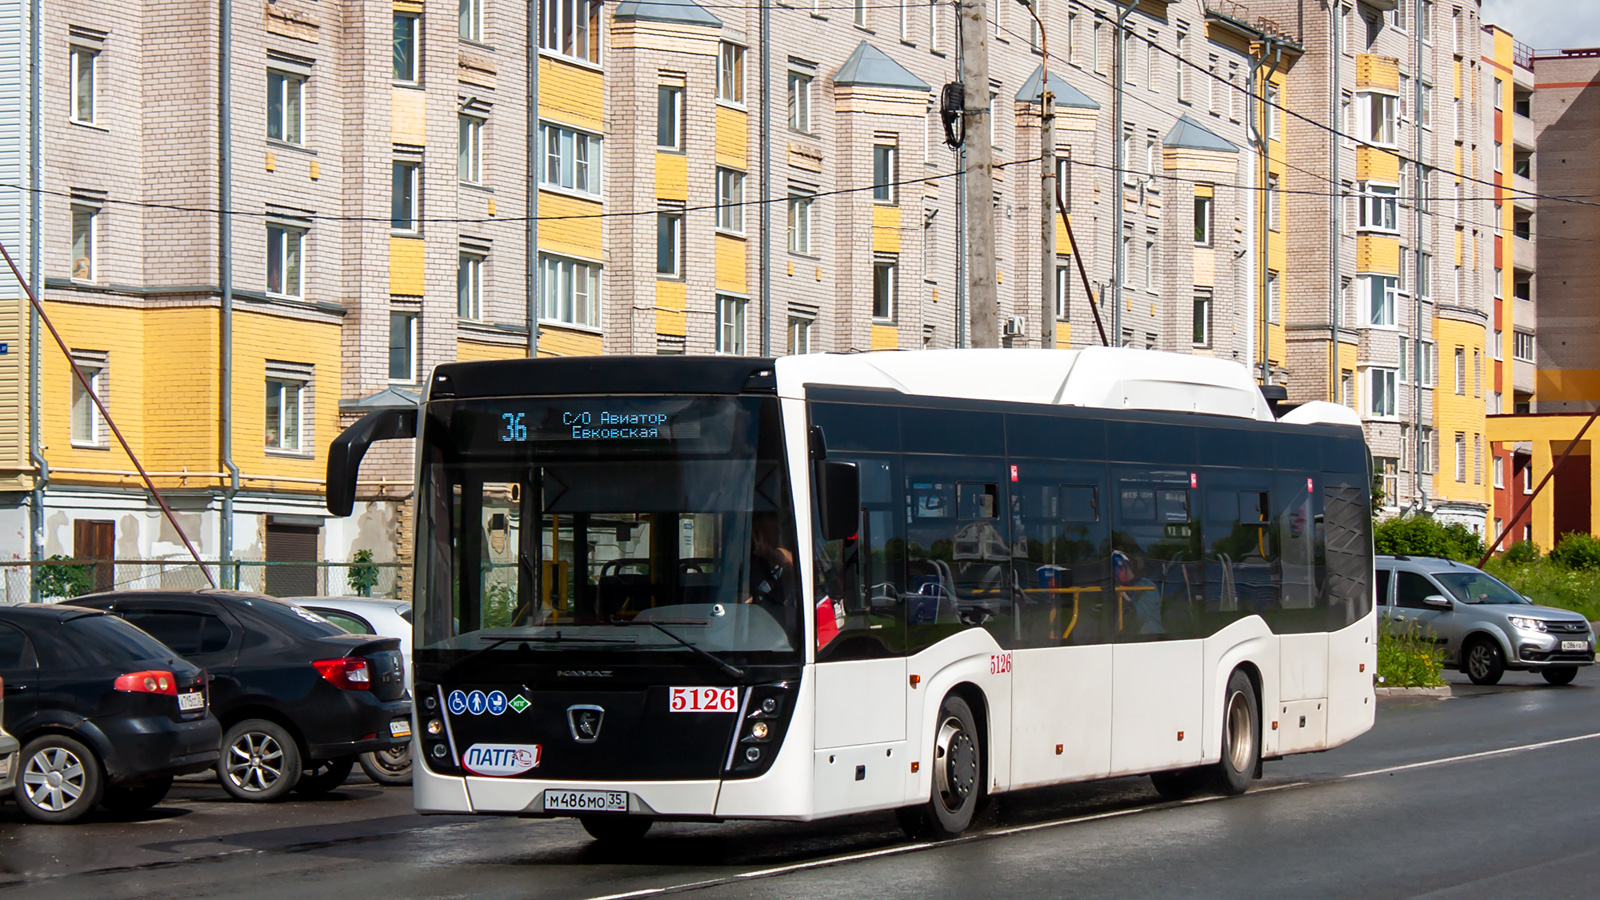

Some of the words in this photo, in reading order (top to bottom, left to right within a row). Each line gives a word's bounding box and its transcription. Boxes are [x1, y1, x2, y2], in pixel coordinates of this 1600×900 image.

[502, 412, 527, 441] 36
[562, 411, 591, 425] С/О
[600, 411, 668, 425] Авиатор
[572, 425, 658, 439] Евковская
[990, 653, 1011, 675] 5126
[671, 688, 736, 711] 5126
[468, 748, 517, 767] ПАТП
[549, 793, 606, 808] М486МО
[608, 793, 622, 805] 35
